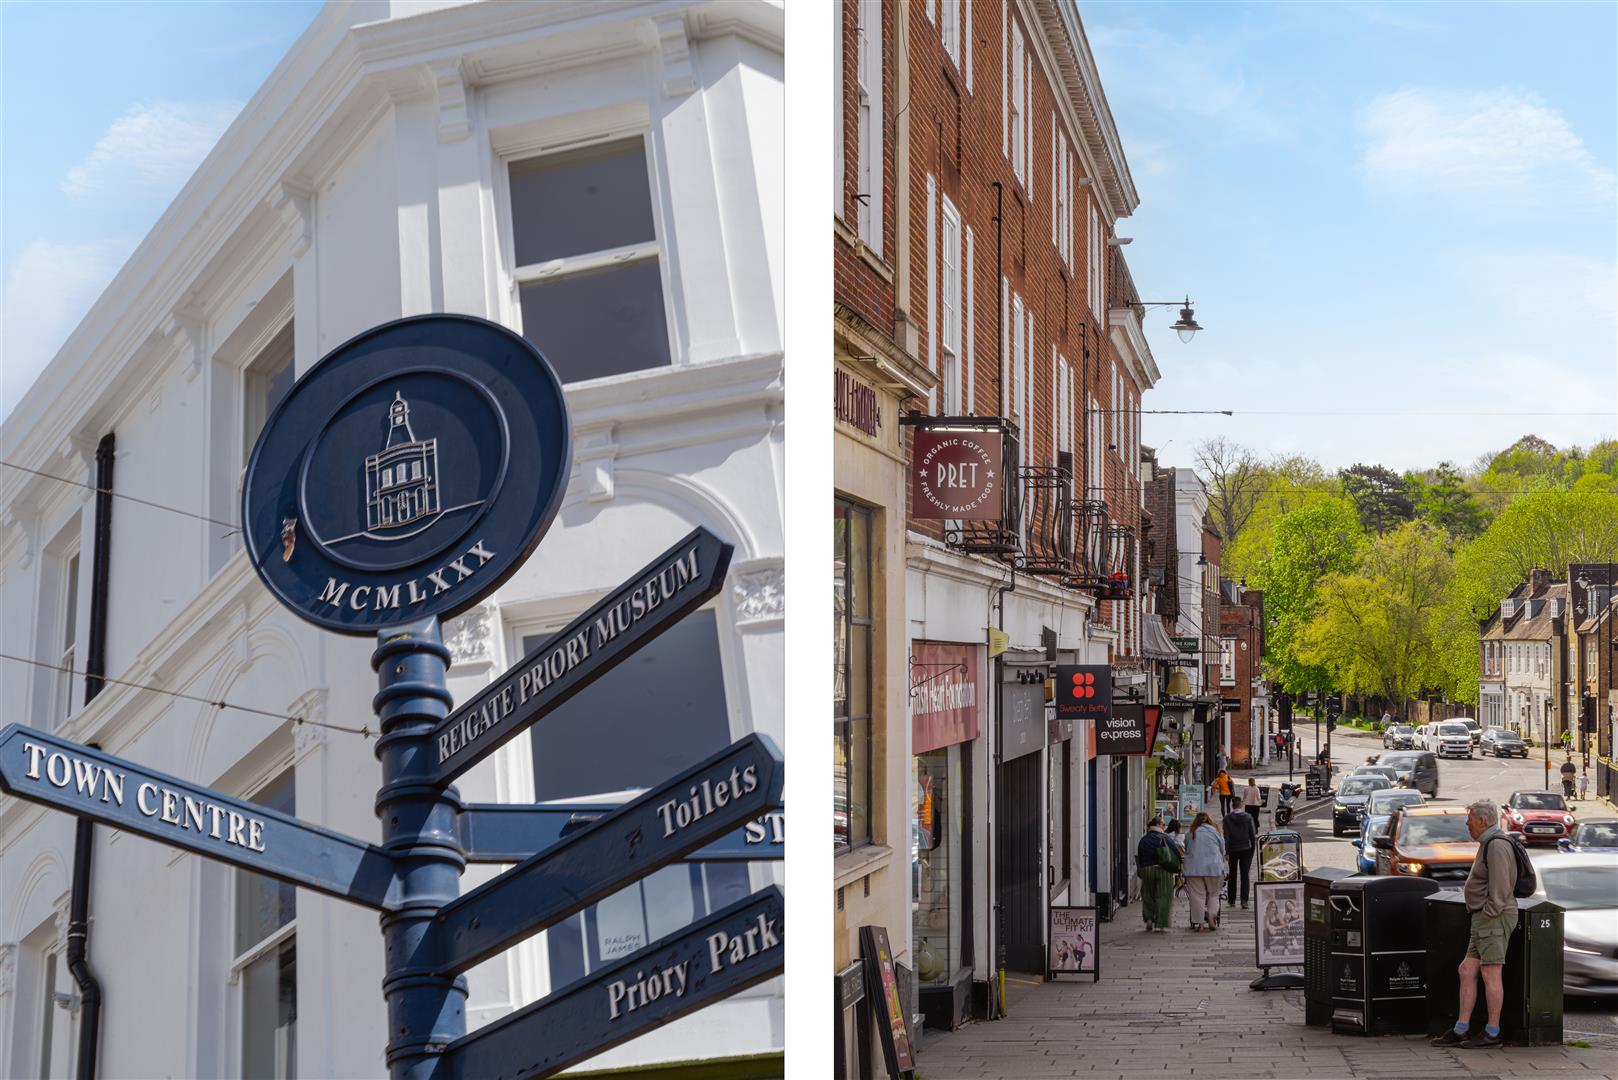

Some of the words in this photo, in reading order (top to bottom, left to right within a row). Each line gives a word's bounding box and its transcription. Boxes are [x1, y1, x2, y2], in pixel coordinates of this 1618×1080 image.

[923, 438, 958, 465] ORGANIC
[962, 439, 992, 465] COFFEE
[937, 462, 979, 488] PRET
[920, 481, 951, 511] FRESHLY
[952, 501, 977, 512] MADE
[977, 482, 993, 503] FOOD
[318, 540, 496, 611] MCMLXXX
[438, 684, 516, 764] REIGATE
[518, 626, 594, 706] PRIORY
[596, 546, 701, 649] MUSEUM
[1060, 703, 1086, 714] Sweaty
[1088, 703, 1108, 713] Betty
[1101, 728, 1141, 740] express
[1106, 717, 1136, 728] vision
[24, 741, 126, 807] TOWN
[136, 781, 267, 852] CENTRE
[656, 763, 758, 839] Toilets
[1053, 917, 1094, 926] ULTIMATE
[1065, 924, 1077, 932] FIT
[1079, 924, 1093, 932] KIT
[1540, 919, 1551, 928] 25
[605, 958, 691, 1021] Priory
[706, 912, 782, 975] Park
